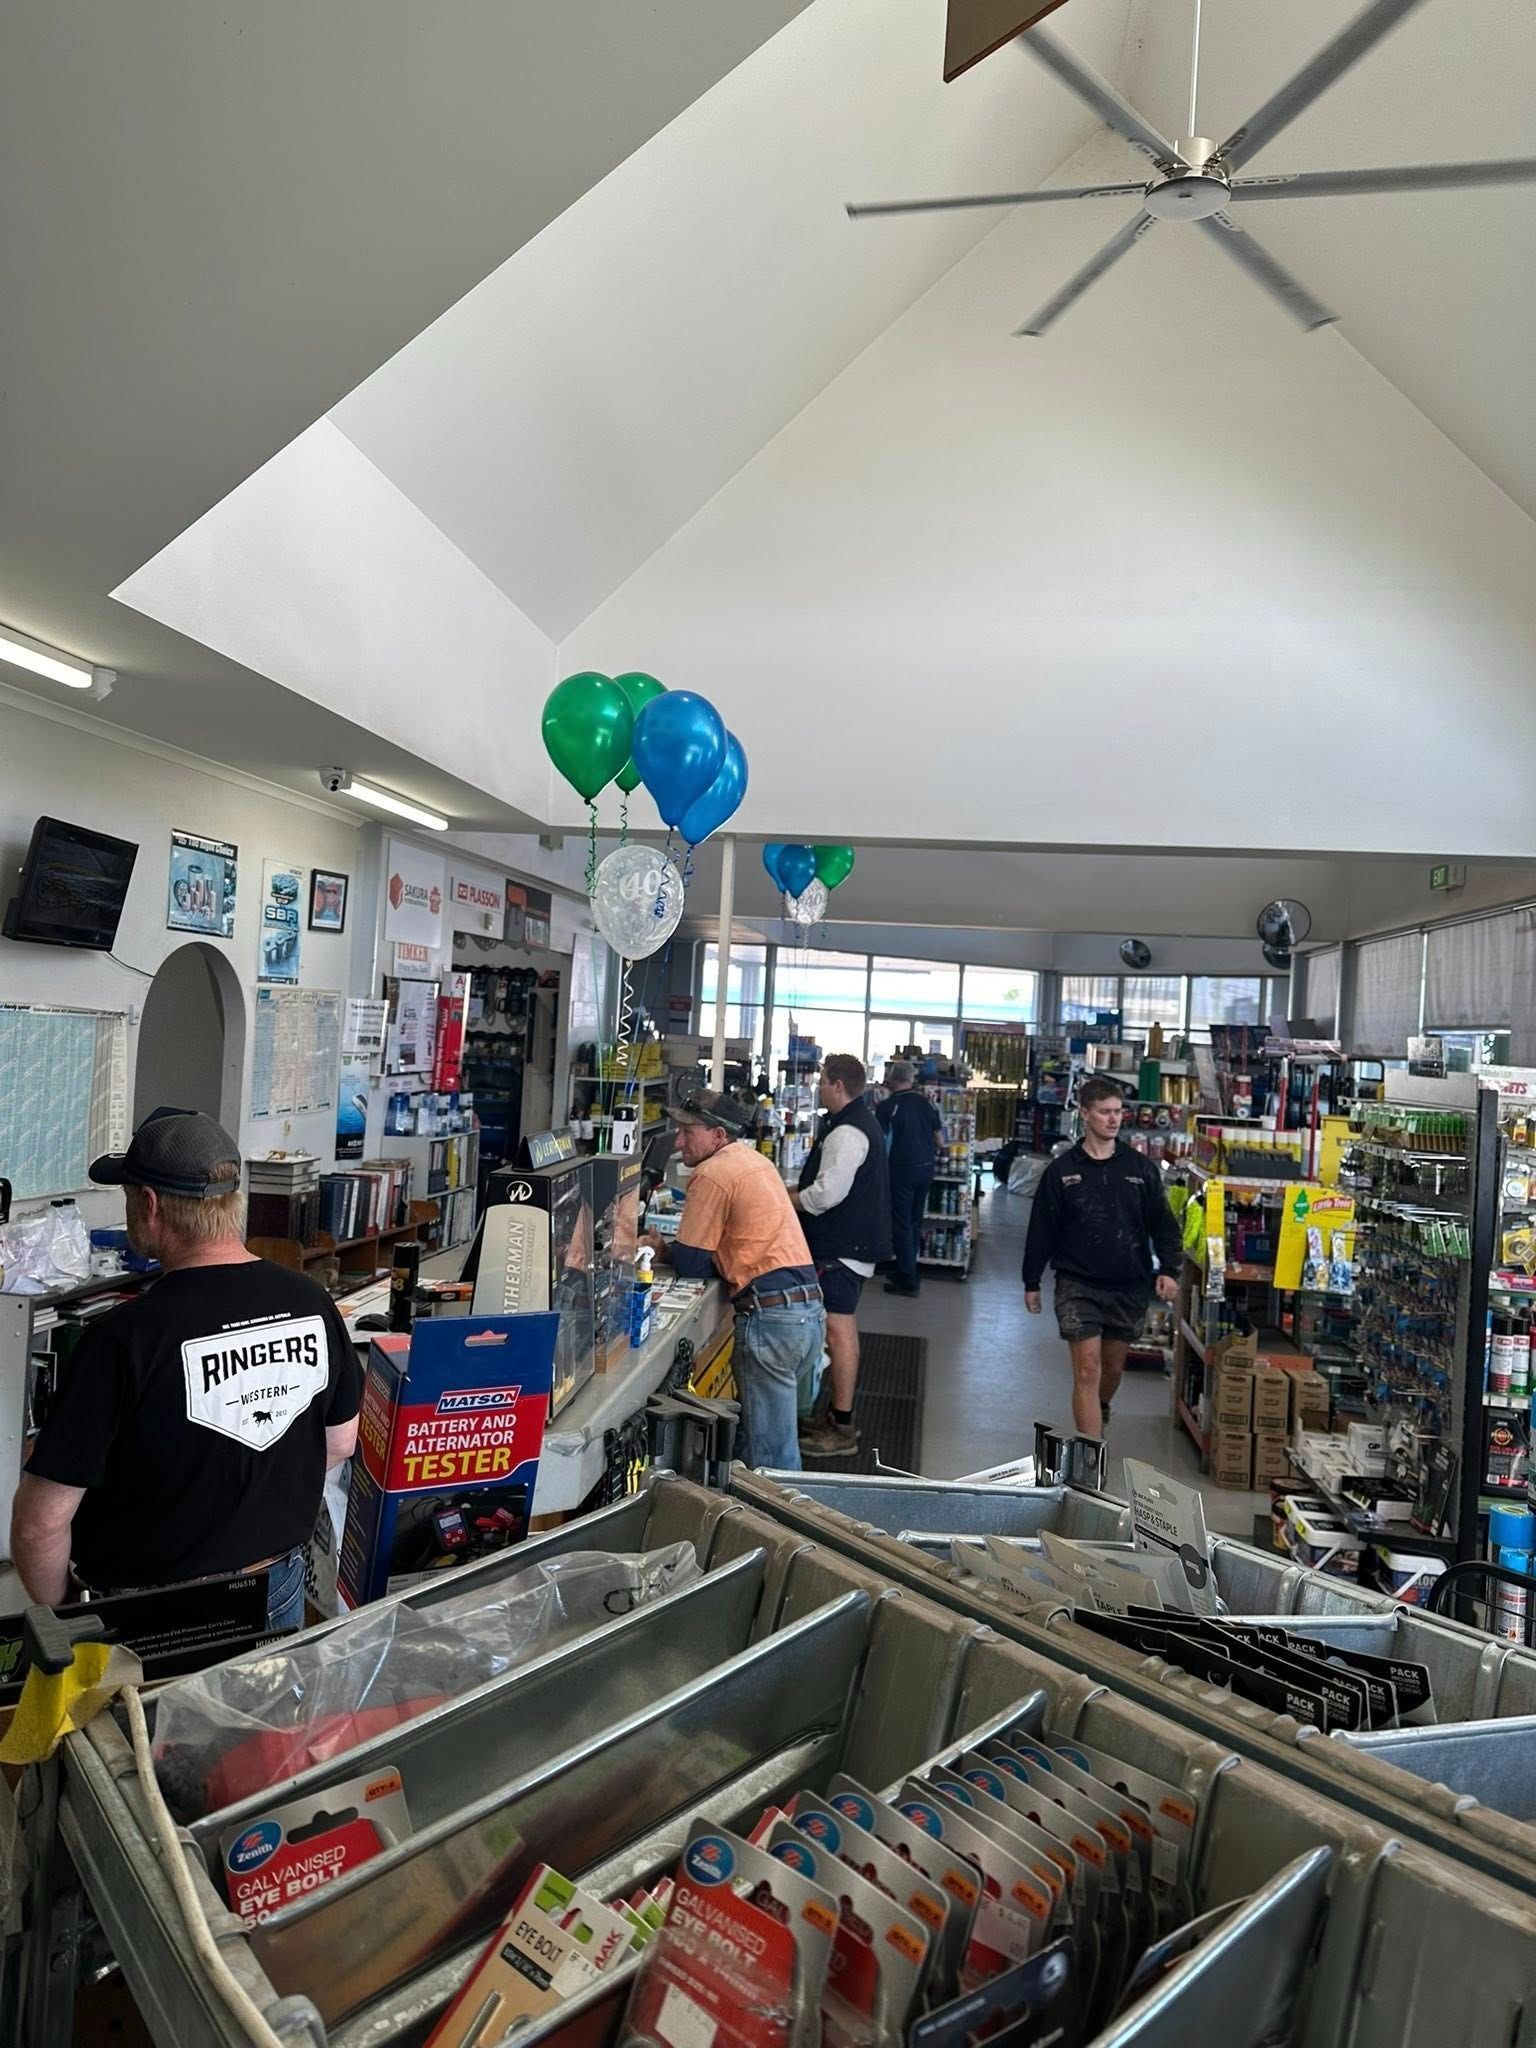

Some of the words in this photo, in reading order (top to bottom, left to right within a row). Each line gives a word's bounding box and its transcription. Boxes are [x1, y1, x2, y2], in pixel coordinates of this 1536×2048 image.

[404, 884, 428, 900] SAKURA
[620, 870, 661, 900] 40
[469, 887, 501, 908] PLASSON
[503, 1220, 526, 1315] ATHERMAN
[201, 1333, 318, 1395] RINGERS
[240, 1384, 288, 1406] WESTERN
[440, 1391, 516, 1409] MATSON
[407, 1417, 480, 1437] BATTERY
[481, 1414, 517, 1430] AND
[404, 1430, 515, 1455] ALTERNATOR
[403, 1447, 512, 1481] TESTER
[228, 1579, 257, 1590] HU6510
[1095, 1598, 1124, 1615] TAPLE
[1259, 1632, 1281, 1644] ACK
[1288, 1642, 1316, 1654] PACK
[1390, 1666, 1420, 1680] PACK
[1286, 1693, 1315, 1712] PACK
[1321, 1687, 1350, 1706] PACK
[236, 1842, 274, 1863] Zenith
[237, 1845, 347, 1899] GALVANISED
[240, 1887, 281, 1916] EYE
[286, 1862, 344, 1897] BOLT
[675, 1887, 768, 1956] GALVANISED
[515, 1920, 538, 1946] EYE
[533, 1934, 563, 1963] BOLT
[669, 1905, 707, 1937] EYE
[706, 1927, 758, 1968] BOLT
